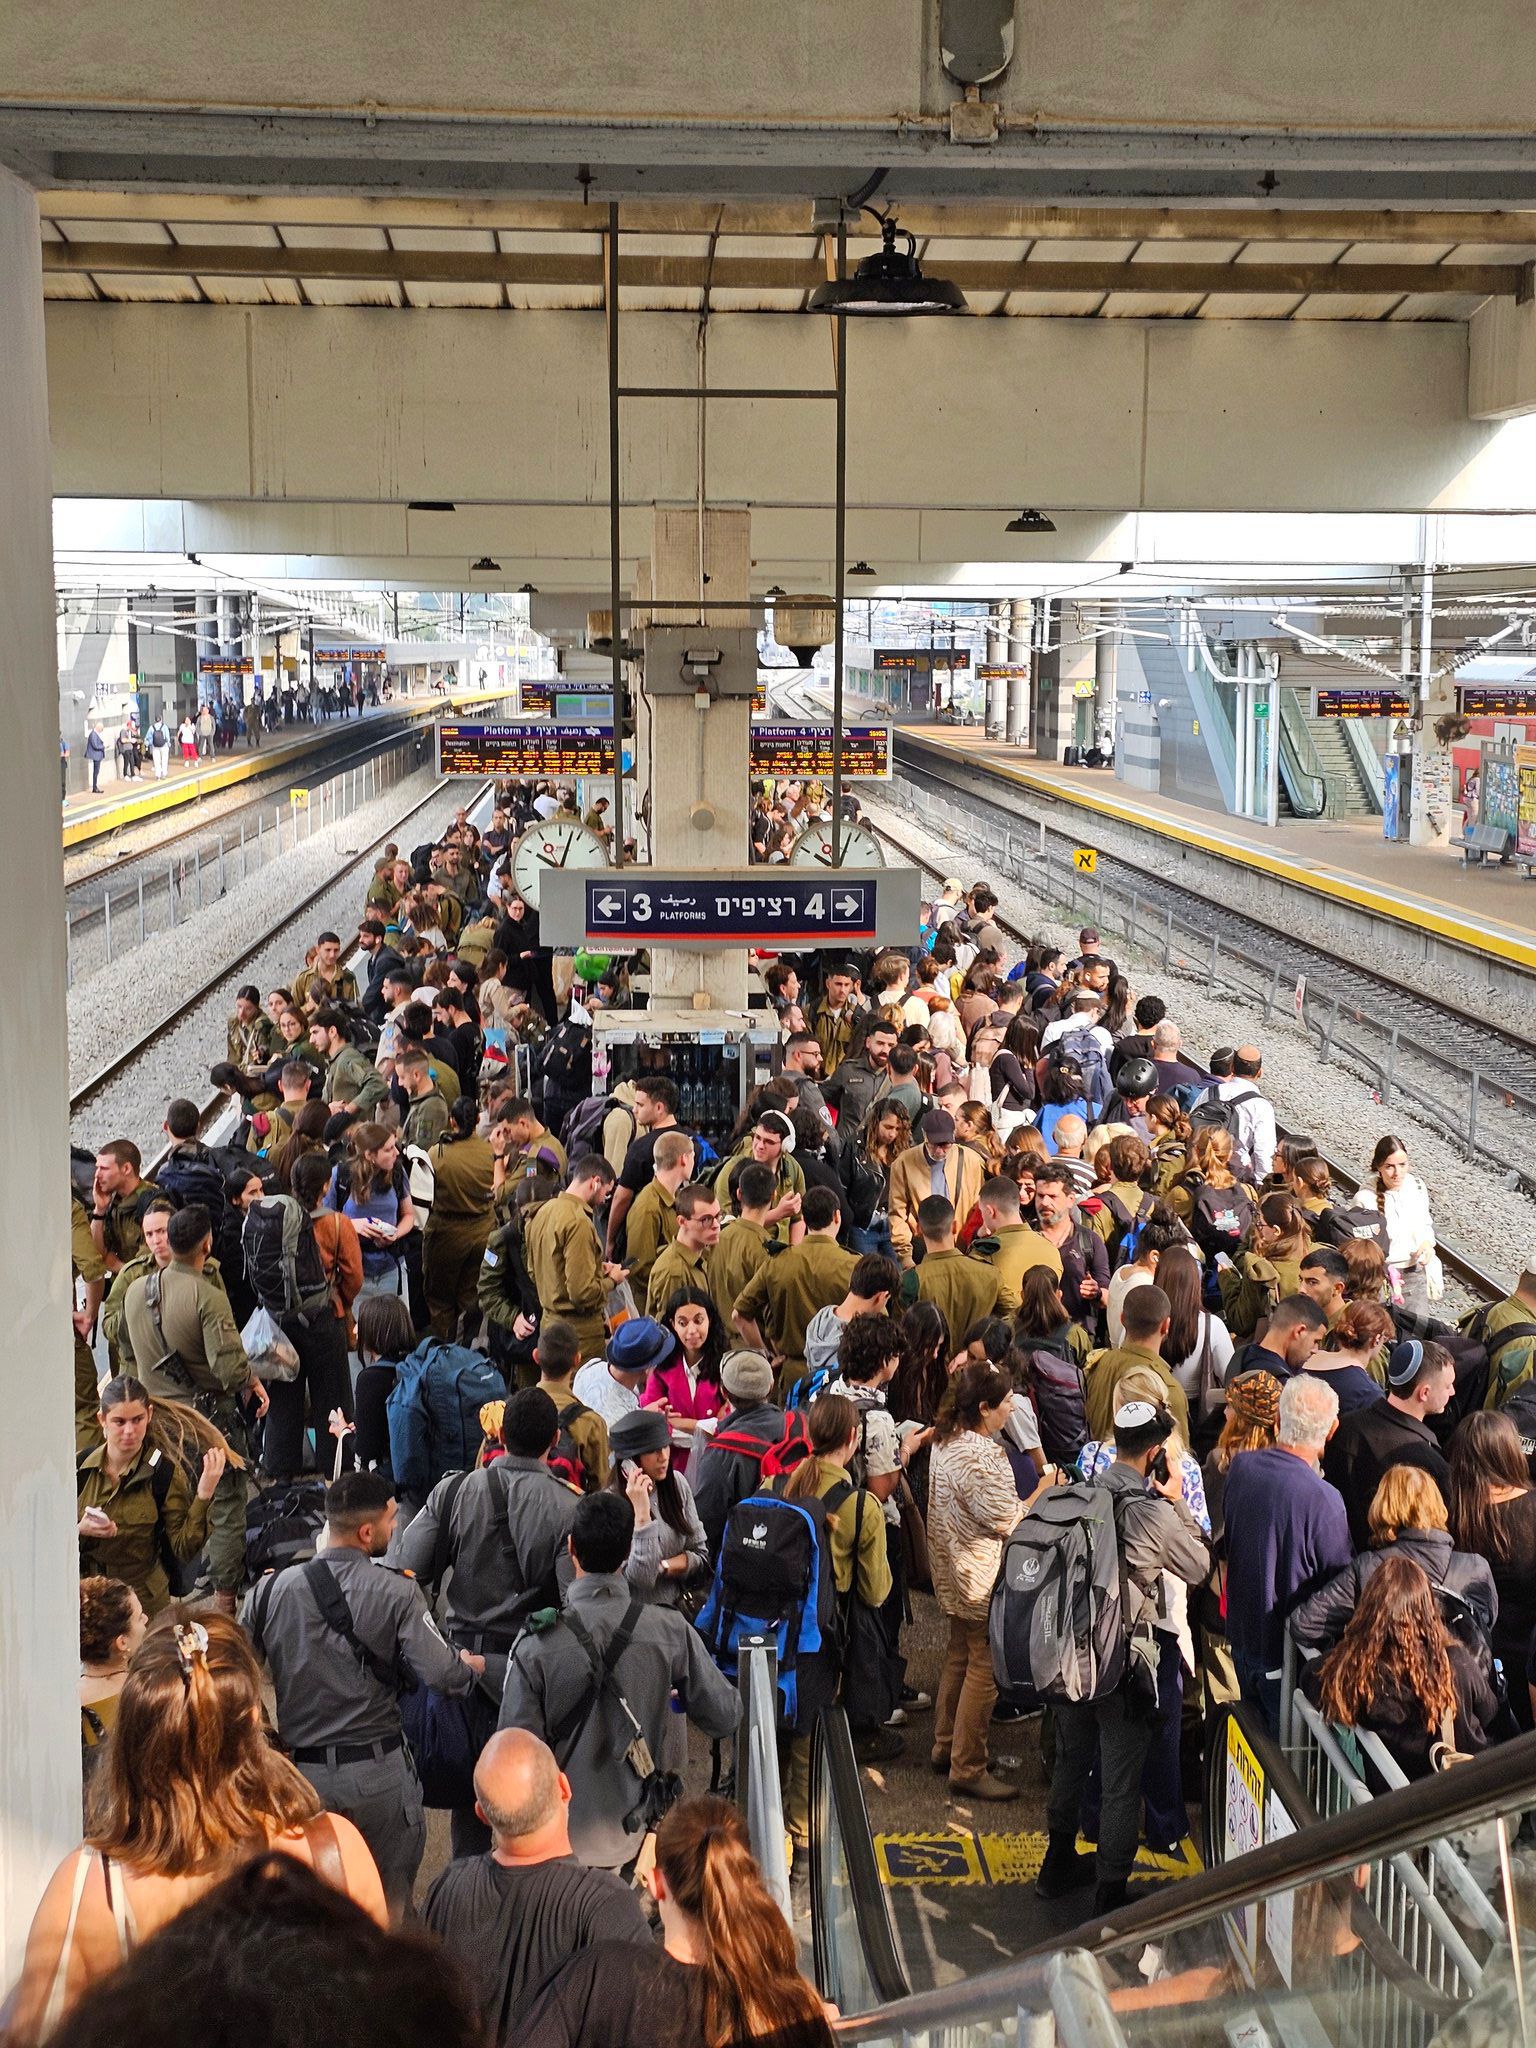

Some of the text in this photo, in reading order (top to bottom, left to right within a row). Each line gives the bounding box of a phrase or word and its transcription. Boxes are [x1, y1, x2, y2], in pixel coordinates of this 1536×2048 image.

[483, 726, 521, 735] Platform
[525, 726, 531, 736] 3
[536, 726, 558, 737] רציף
[759, 727, 832, 738] Platform 4 רציף
[1079, 854, 1092, 867] א
[660, 894, 697, 907] رصيف
[715, 896, 797, 917] רציפים
[804, 893, 826, 920] 4
[632, 893, 652, 922] 3
[659, 911, 707, 920] PLATFORMS
[1236, 1742, 1261, 1805] זהירות
